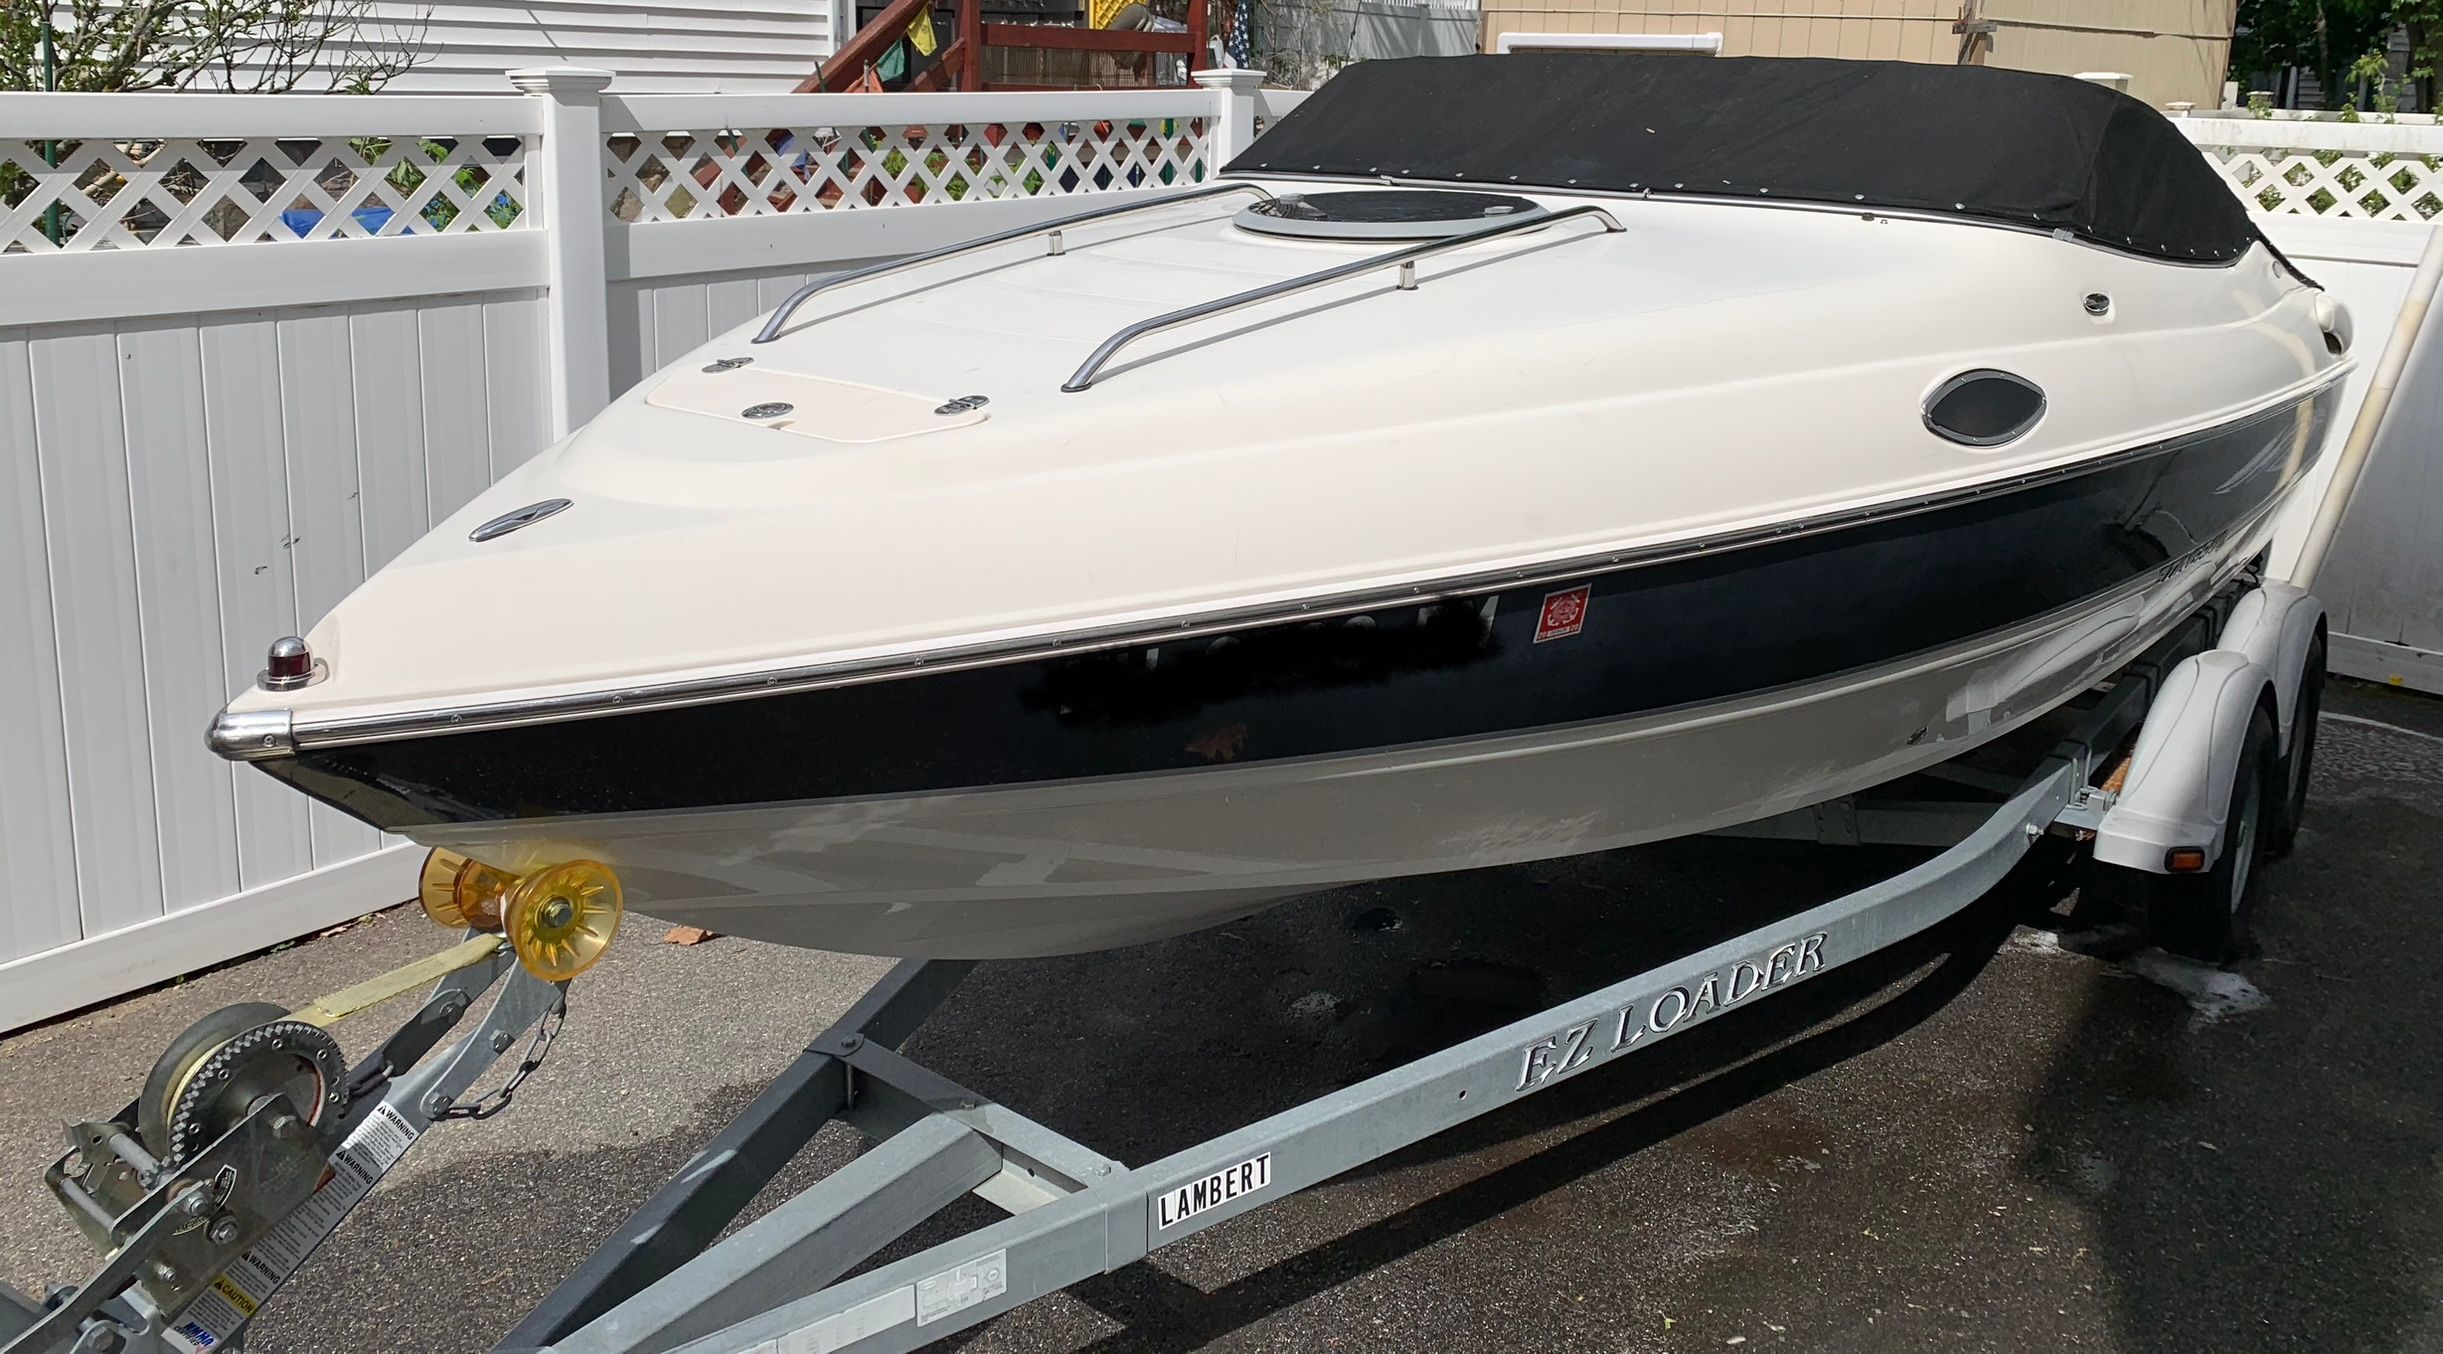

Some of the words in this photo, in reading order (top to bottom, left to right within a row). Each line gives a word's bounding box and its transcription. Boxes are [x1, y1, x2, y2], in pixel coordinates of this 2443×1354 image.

[1515, 1017, 1599, 1092] EZ
[1610, 931, 1828, 1053] LOADER
[386, 1109, 415, 1141] WARNING
[344, 1154, 374, 1185] WARNING
[1161, 1154, 1269, 1227] LAMBERT
[248, 1256, 280, 1285] WARNING
[222, 1284, 254, 1314] CAUTION
